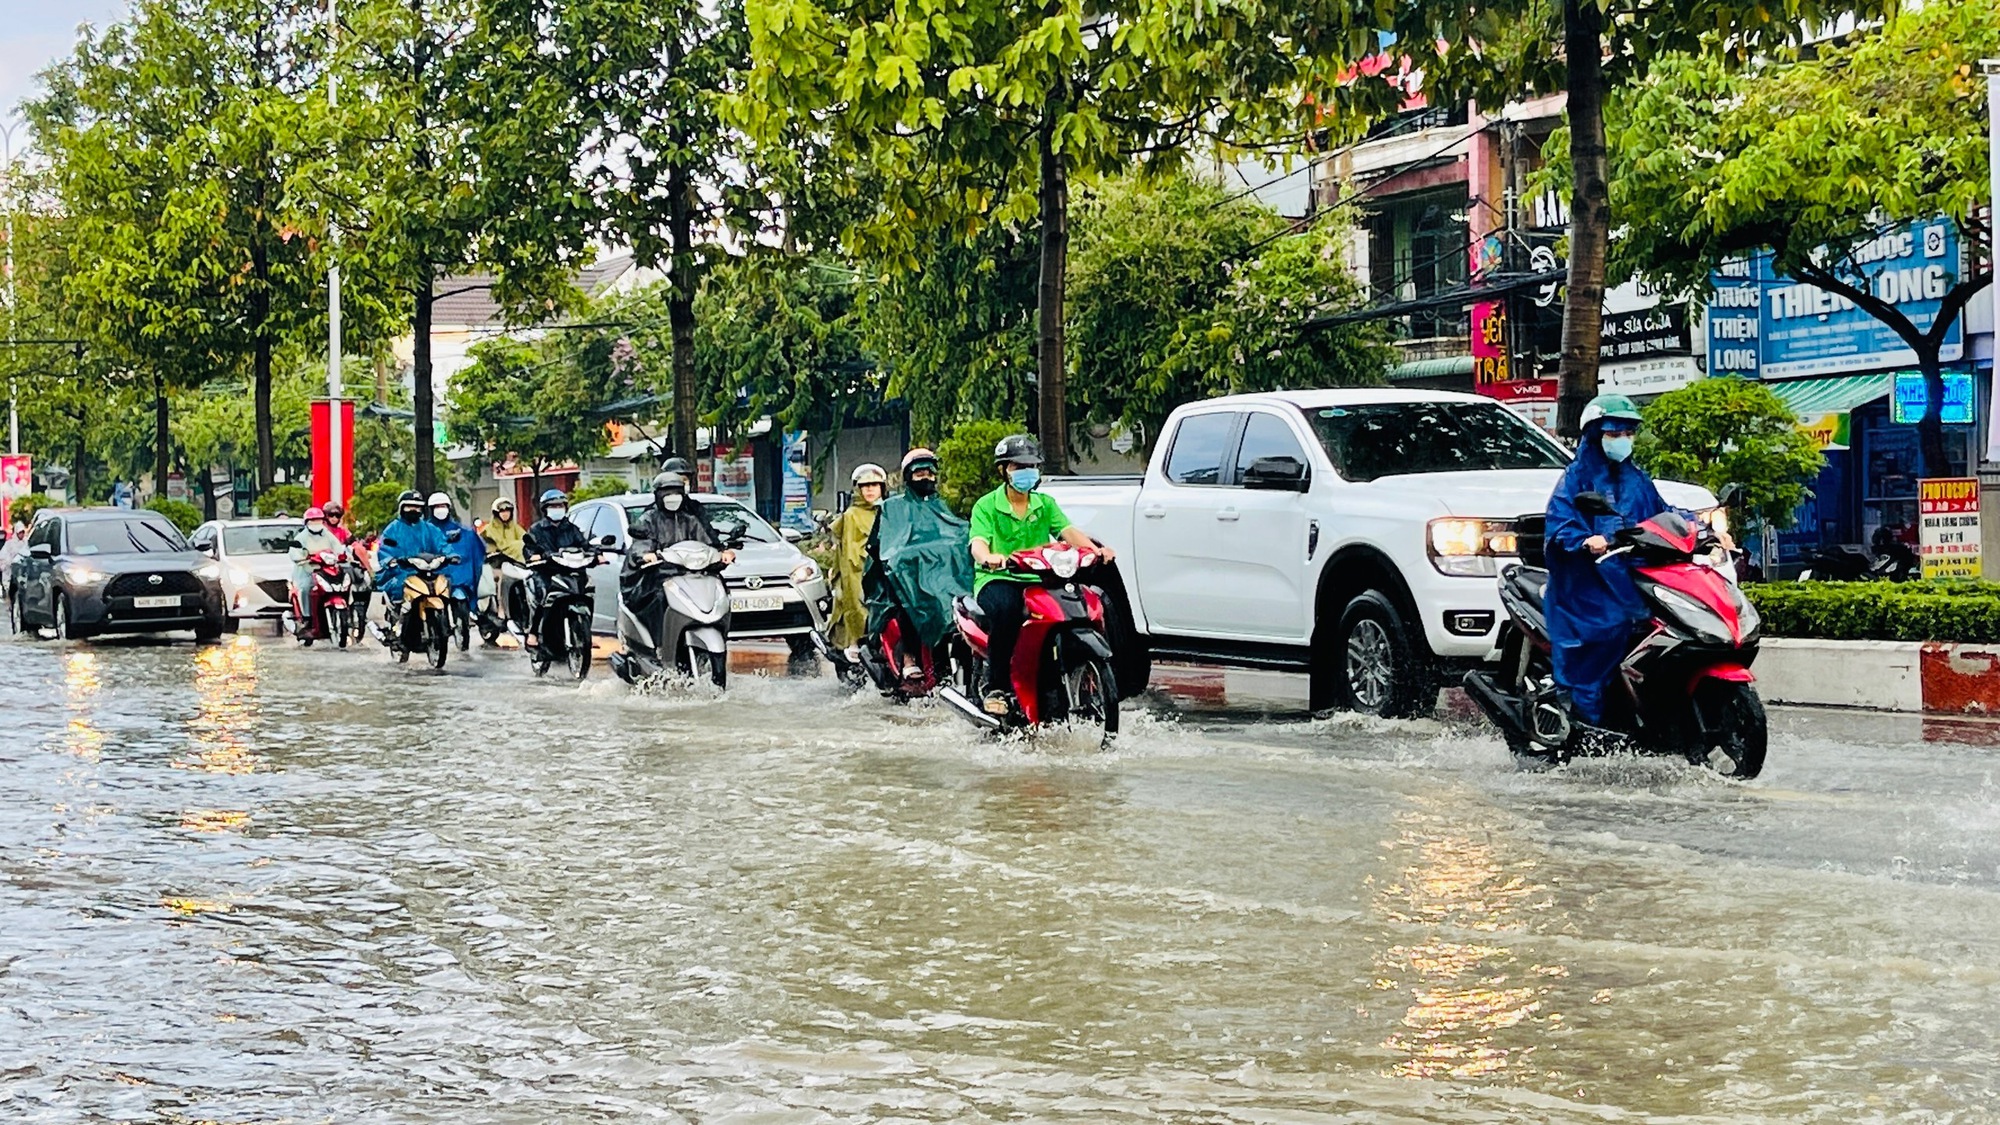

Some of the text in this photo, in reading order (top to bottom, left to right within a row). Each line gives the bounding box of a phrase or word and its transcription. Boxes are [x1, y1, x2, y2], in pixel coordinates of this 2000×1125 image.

[1868, 264, 1946, 305] ONG
[1712, 313, 1758, 342] THIỆN
[1714, 348, 1757, 371] LONG
[1922, 482, 1977, 500] PHOTOCOPY
